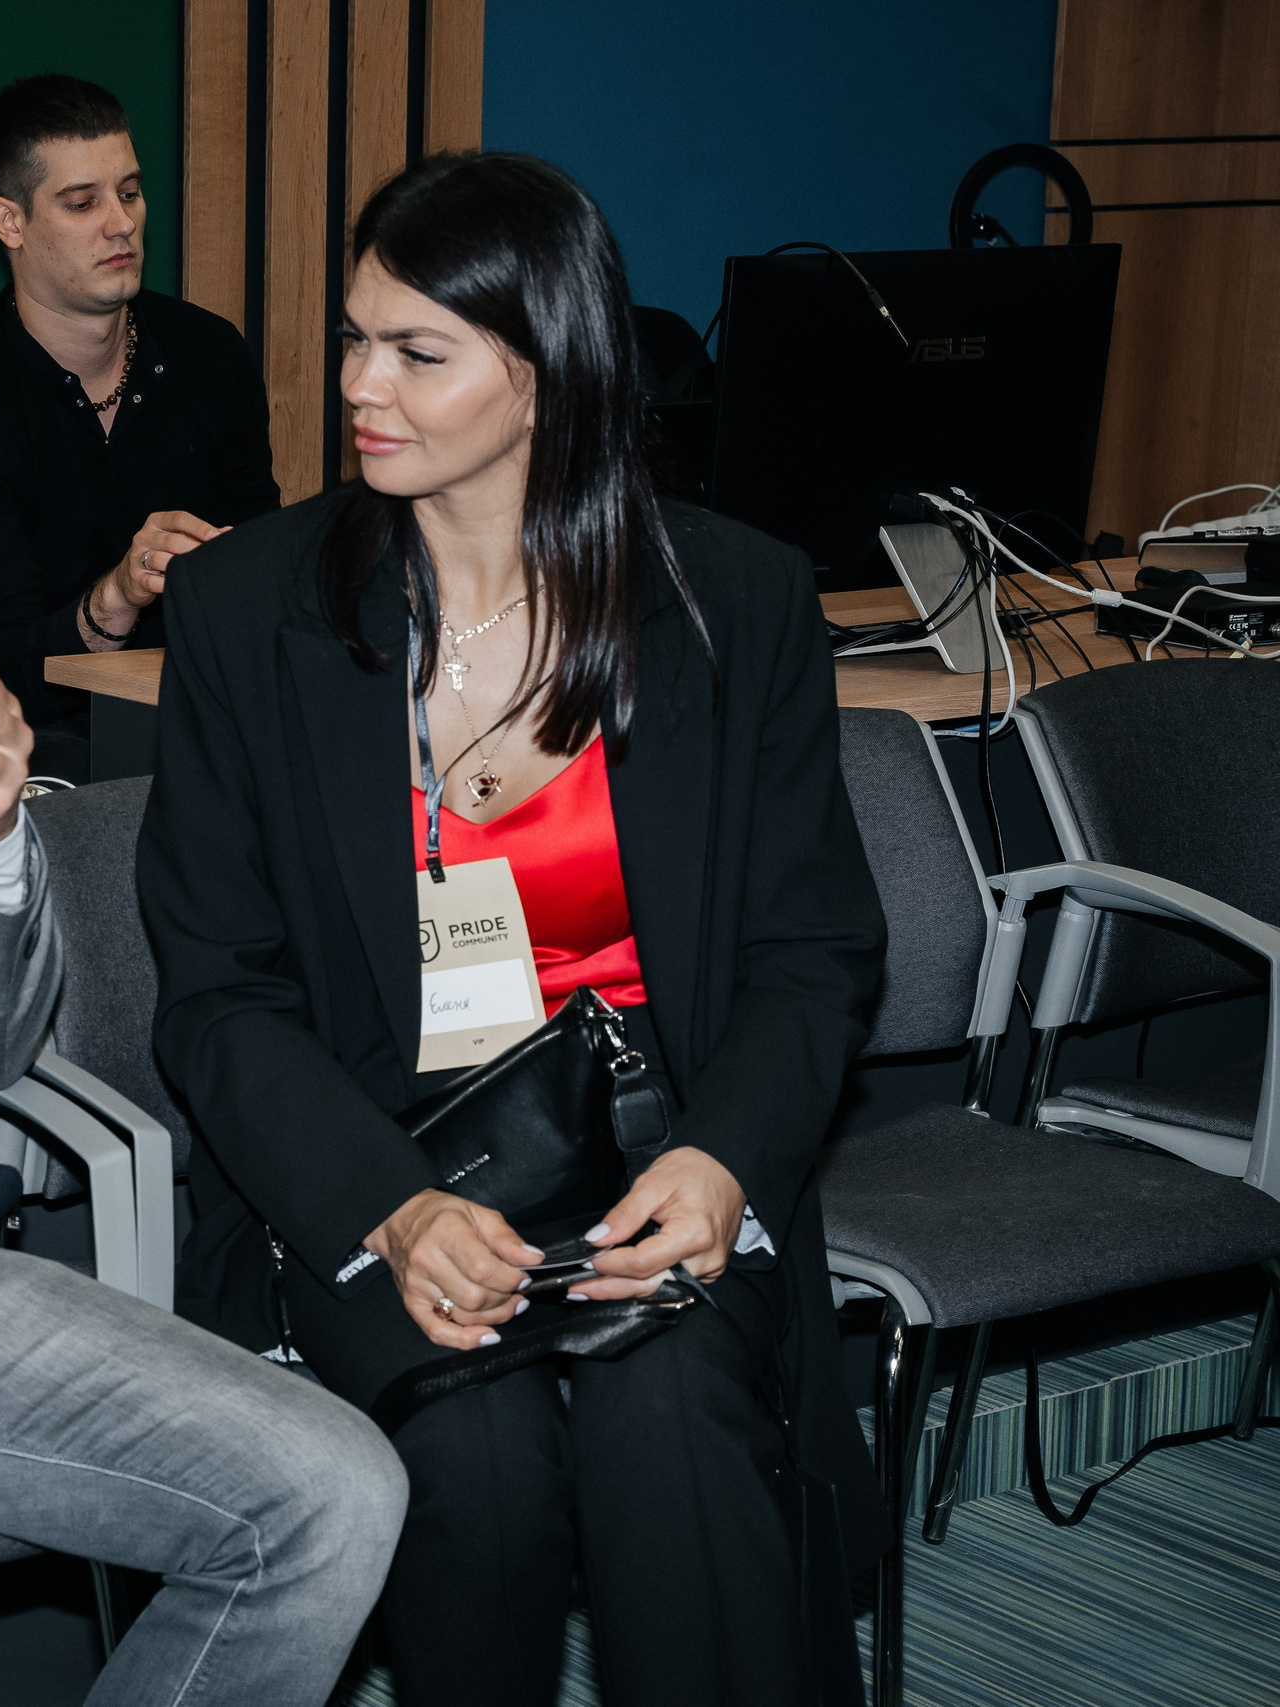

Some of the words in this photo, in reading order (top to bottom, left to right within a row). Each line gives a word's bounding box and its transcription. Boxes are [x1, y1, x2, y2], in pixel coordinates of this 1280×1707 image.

[910, 336, 986, 362] ASUS
[448, 916, 508, 939] PRIDE
[452, 933, 509, 949] COMMUNITY
[472, 1038, 485, 1046] VIP
